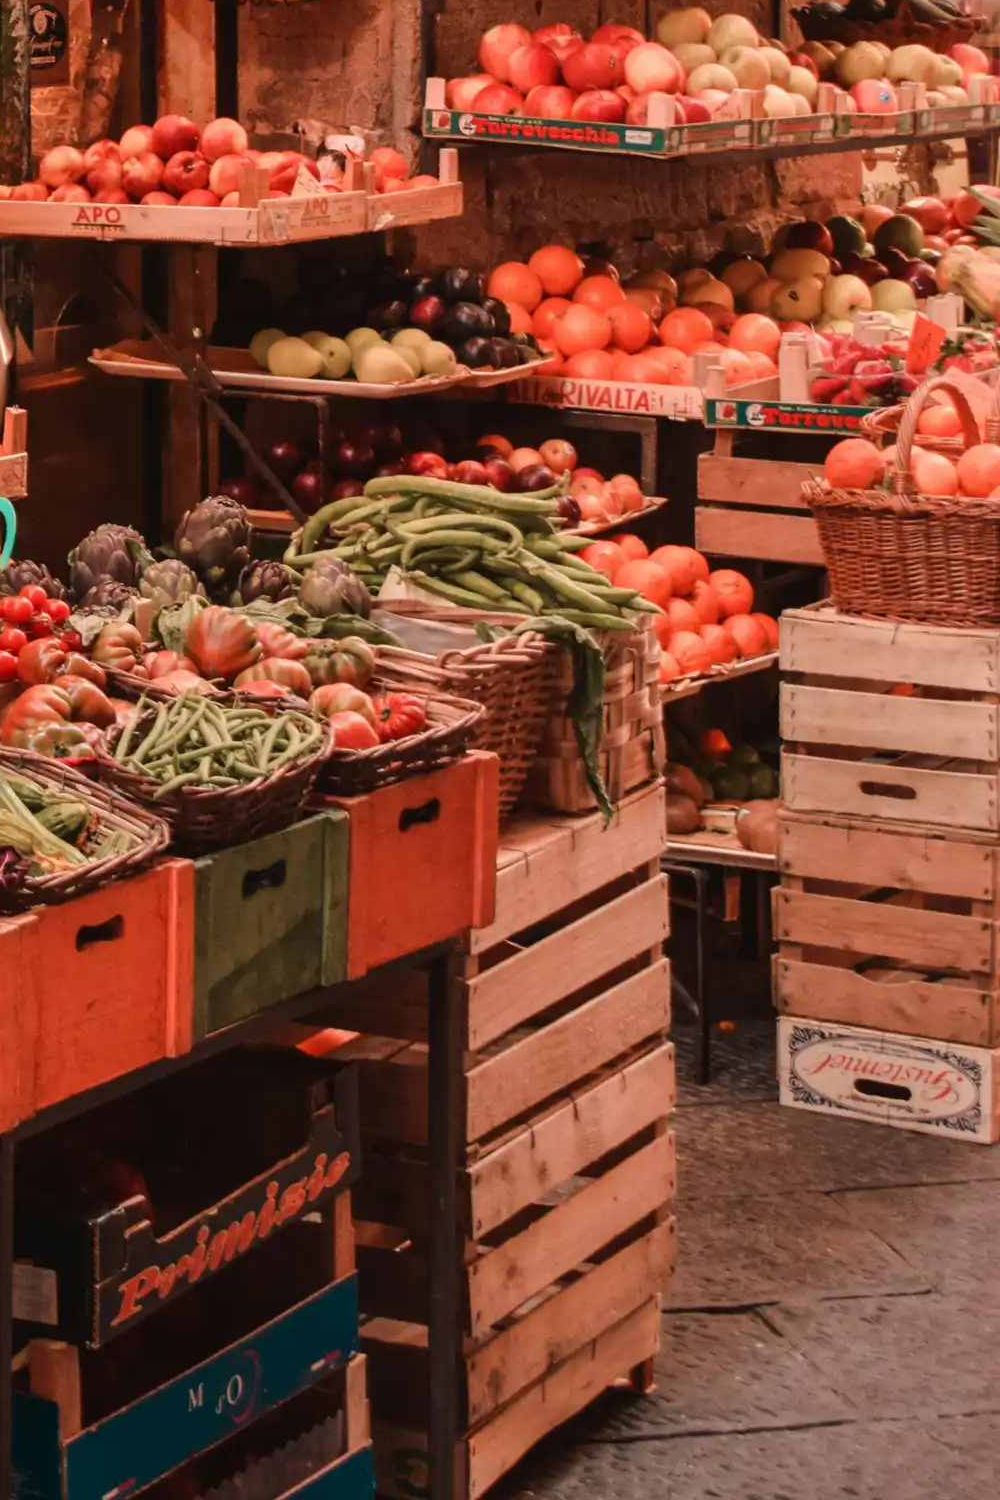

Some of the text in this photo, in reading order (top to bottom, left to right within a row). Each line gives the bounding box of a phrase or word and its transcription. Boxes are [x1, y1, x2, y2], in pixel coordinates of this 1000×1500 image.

[471, 116, 620, 145] Torrevecchia
[76, 205, 122, 224] APO
[560, 380, 650, 413] RIVALTA
[762, 406, 861, 430] Torreve
